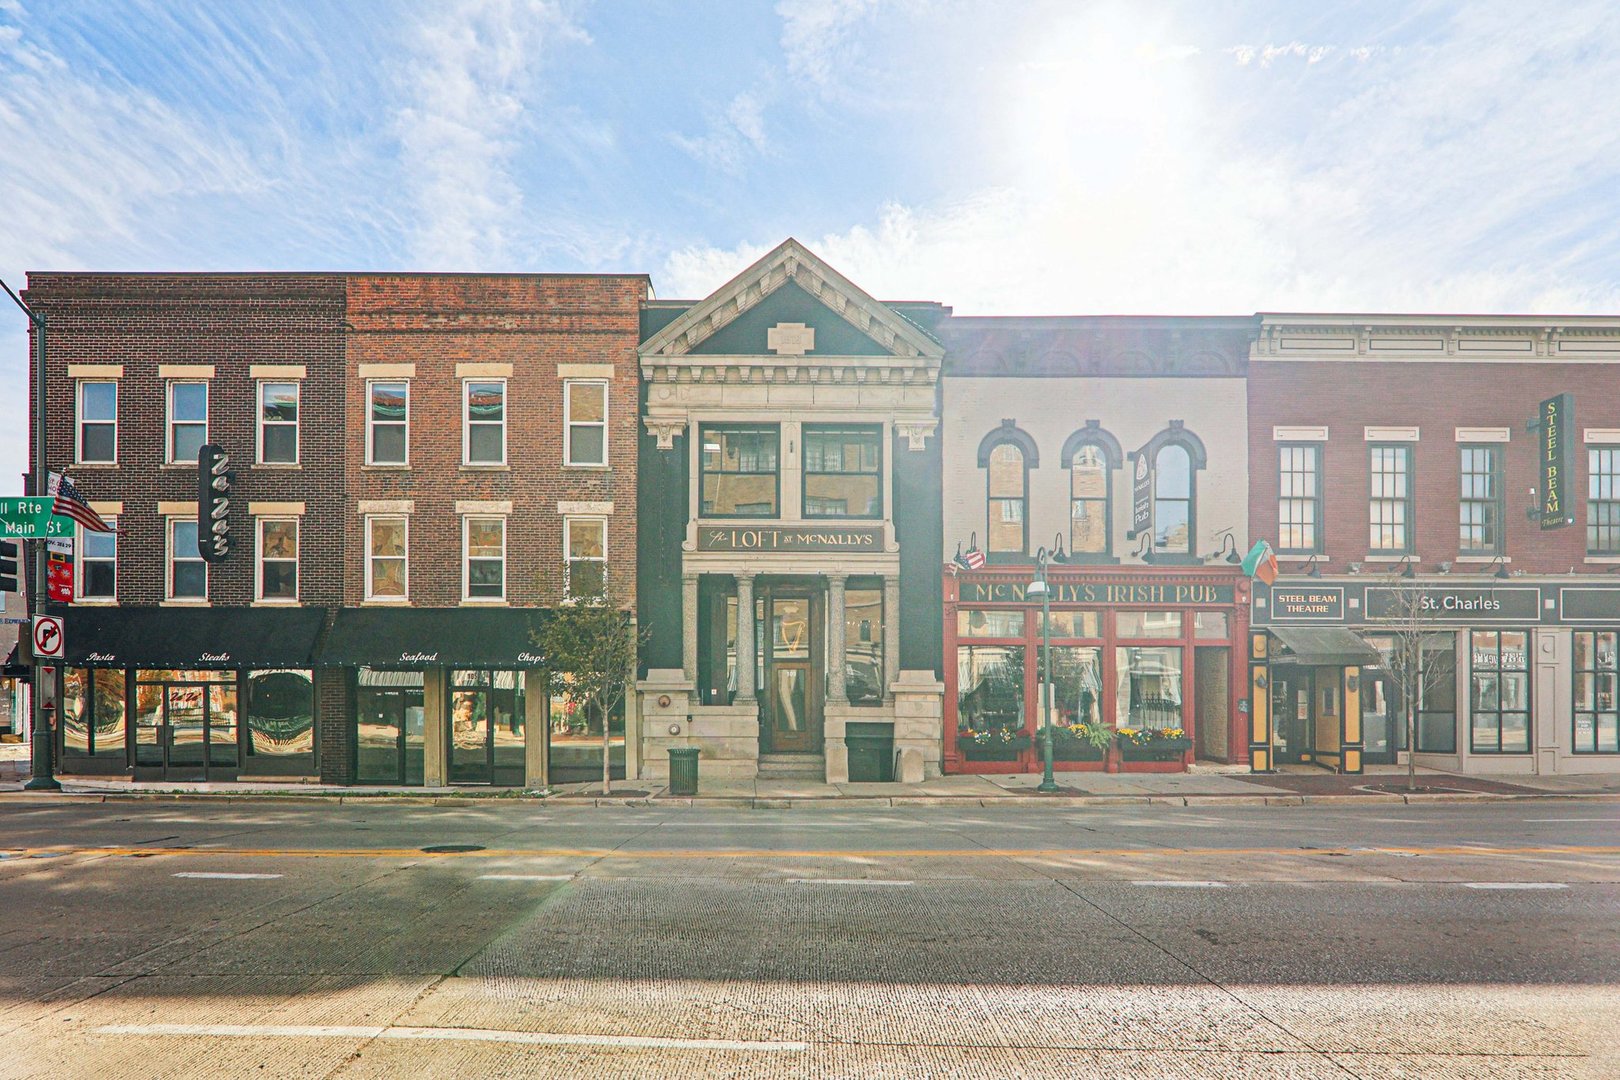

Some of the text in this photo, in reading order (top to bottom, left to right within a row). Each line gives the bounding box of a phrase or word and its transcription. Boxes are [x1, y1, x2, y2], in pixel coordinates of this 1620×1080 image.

[1545, 402, 1560, 514] STEEL BEAM
[18, 501, 42, 514] Rte
[5, 521, 62, 534] Main St
[709, 530, 728, 547] The
[732, 530, 782, 547] LOFT
[783, 535, 793, 544] AT
[1107, 585, 1164, 602] IRISH
[1176, 585, 1218, 603] PUB
[1278, 595, 1337, 603] STEEL BEAM
[1286, 605, 1329, 613] THEATRE
[1420, 595, 1500, 610] St. Charles
[86, 652, 116, 662] Pasta
[198, 652, 231, 662] Steaks
[400, 651, 438, 664] Seafood
